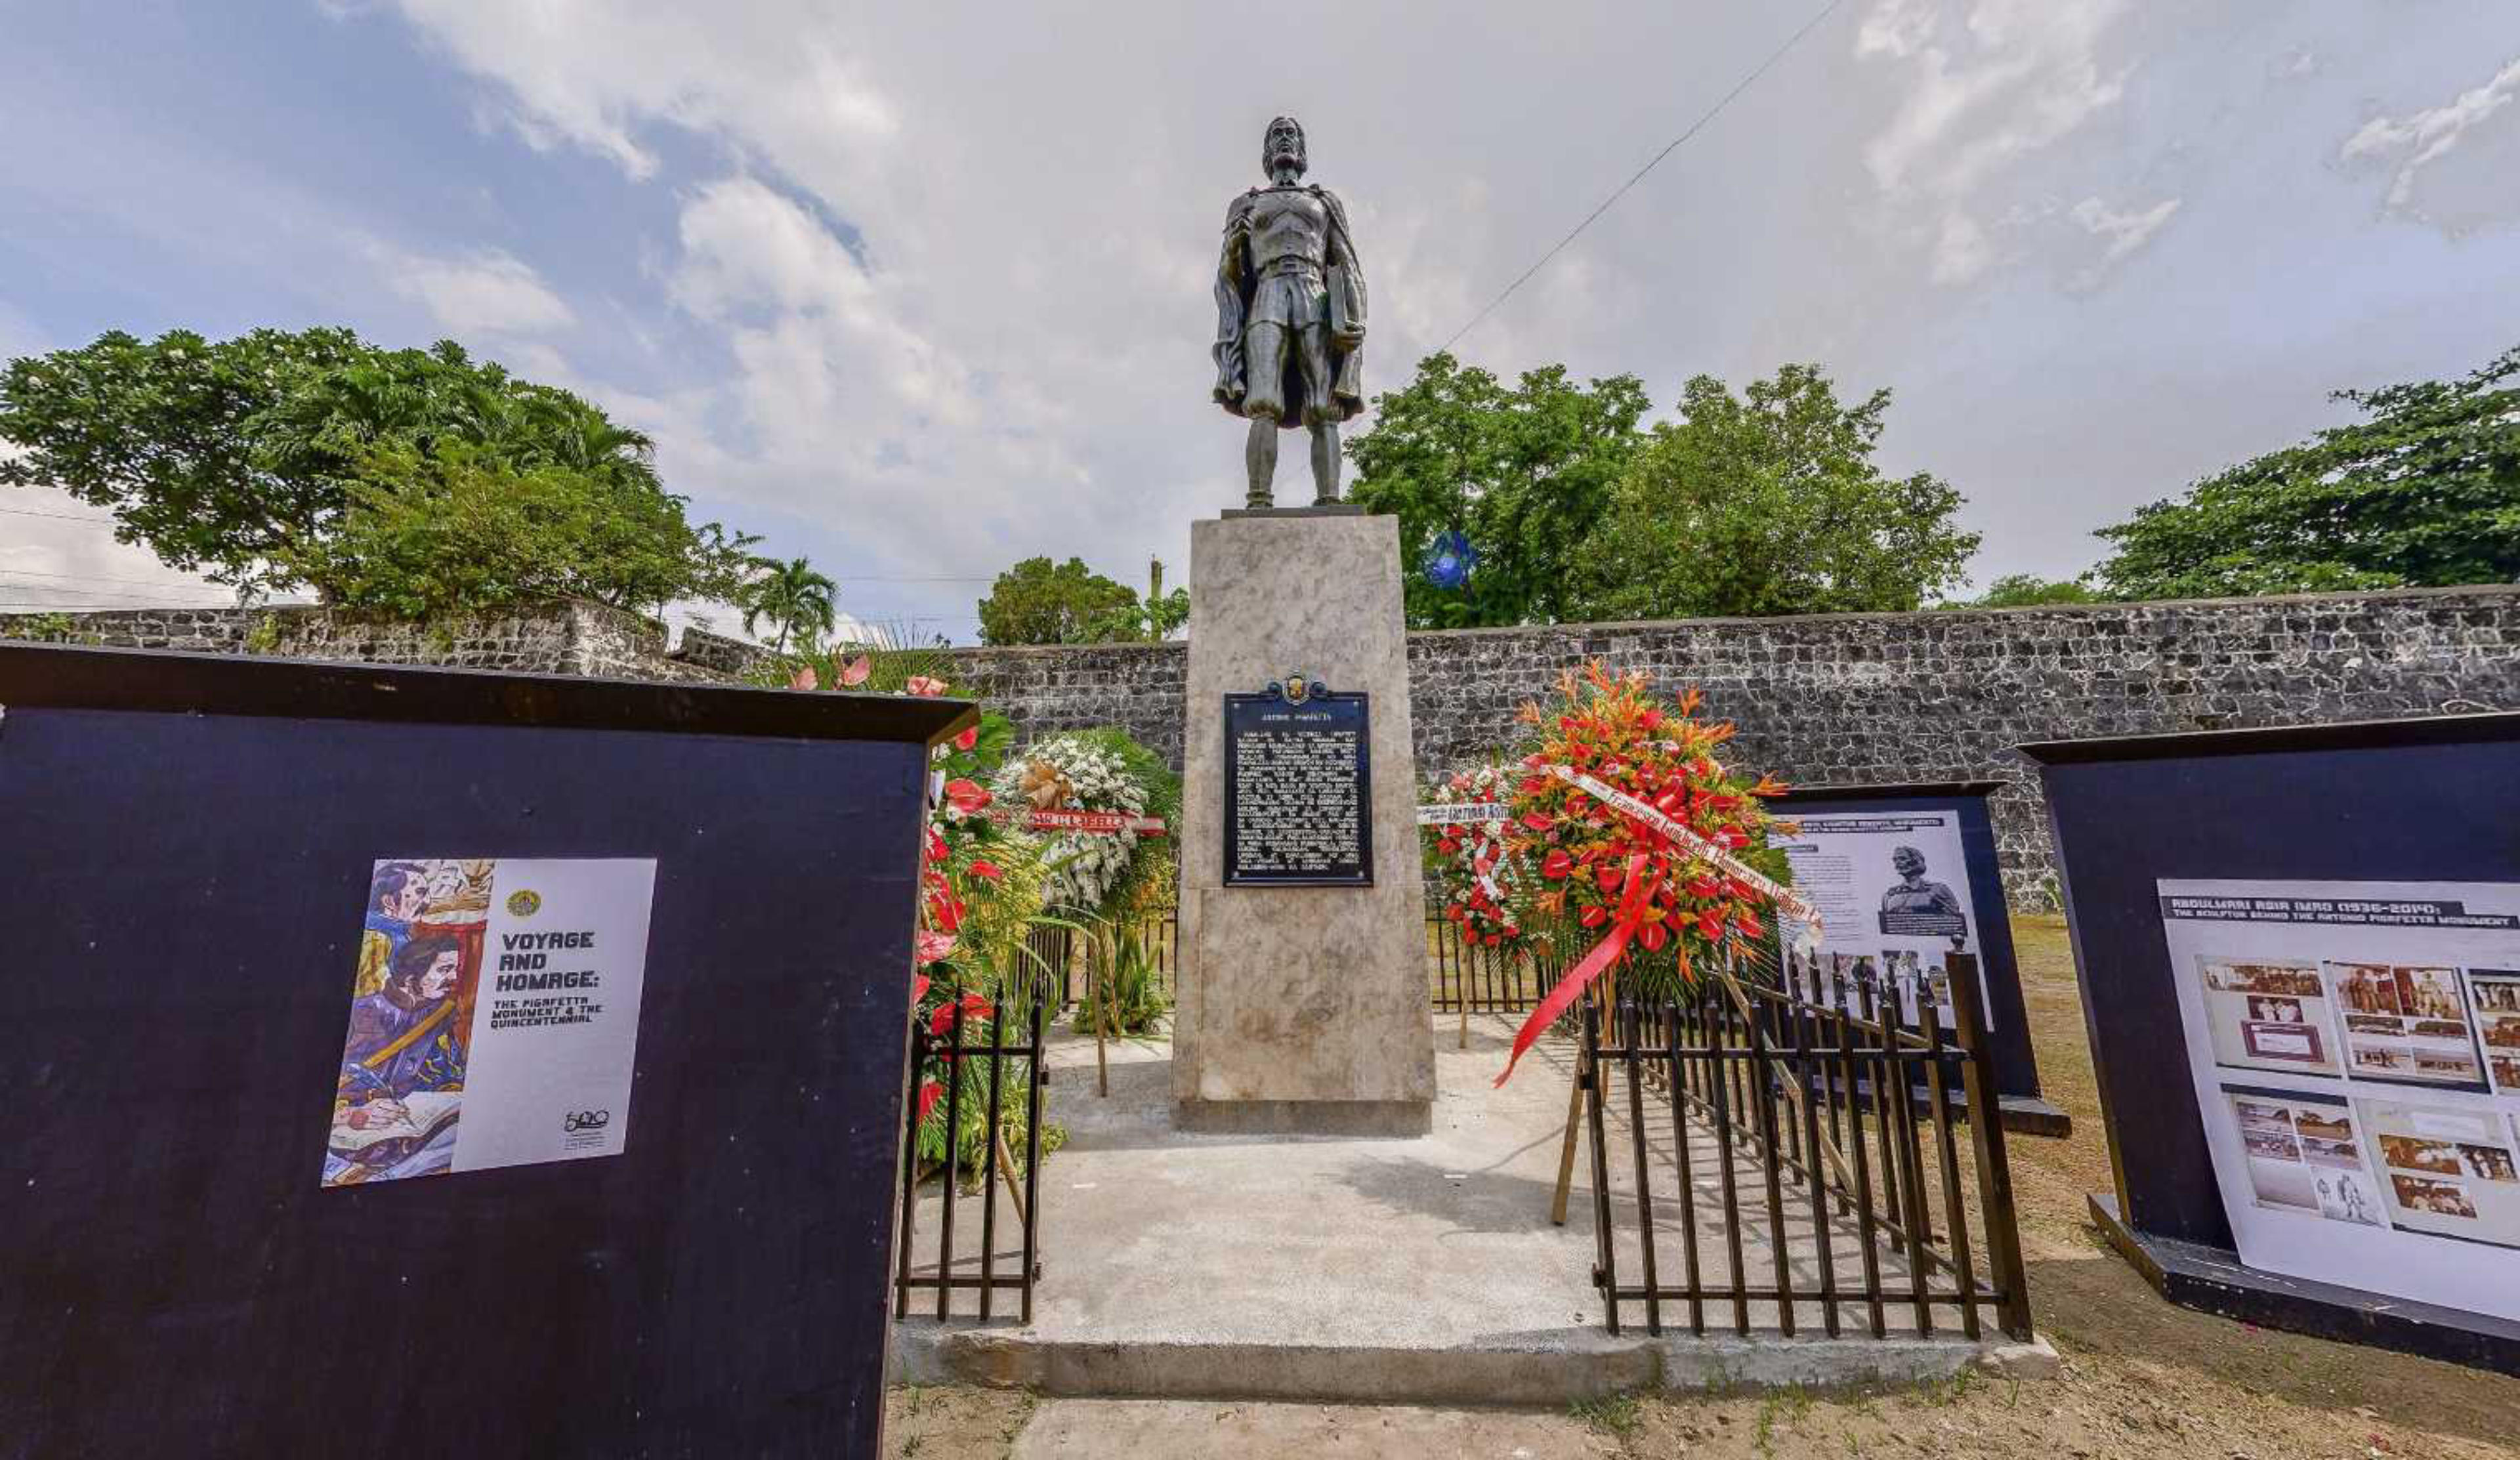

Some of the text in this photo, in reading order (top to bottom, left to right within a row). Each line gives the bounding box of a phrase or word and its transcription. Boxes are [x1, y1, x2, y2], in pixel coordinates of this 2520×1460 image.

[2172, 898, 2251, 909] ABDULMARI
[2196, 910, 2248, 919] SCULPTOR
[502, 932, 595, 951] VOYAGE
[499, 953, 547, 971] AND
[495, 970, 600, 992] HOMAGE:
[494, 997, 589, 1009] THE PIGAFETTA
[492, 1005, 603, 1020] MONUMENT & THE
[491, 1015, 593, 1029] QUINCENTENNIAL
